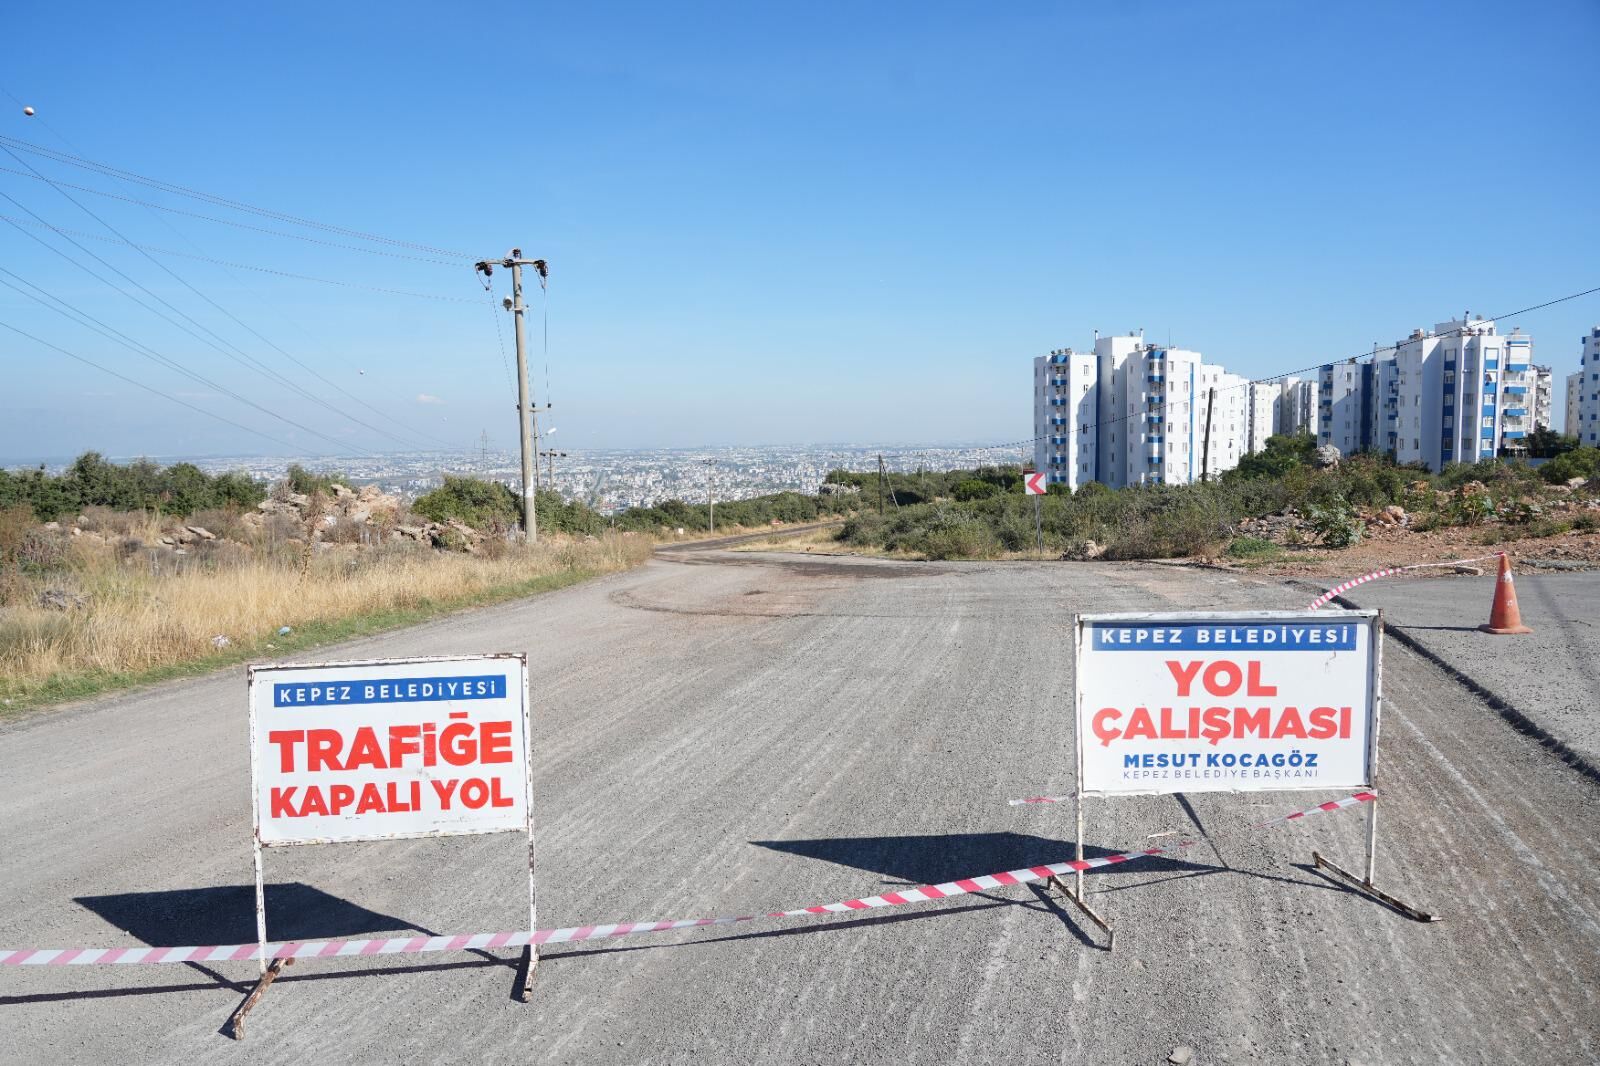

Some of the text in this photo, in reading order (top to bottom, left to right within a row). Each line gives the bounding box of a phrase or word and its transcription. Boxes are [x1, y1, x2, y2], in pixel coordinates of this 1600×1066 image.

[1101, 627, 1348, 644] KEPEZ BELEDİYESİ
[280, 680, 496, 702] KEPEZ BELEDİYESİ
[1166, 661, 1277, 697] YOL
[1092, 707, 1352, 747] ÇALIŞMASI
[269, 711, 513, 773] TRAFİĞE
[1124, 750, 1318, 768] MESUT KOCAGÖZ
[1123, 769, 1318, 780] KEPEZ BELEDİYE BAŞKANI
[271, 777, 514, 818] KAPALI YOL
